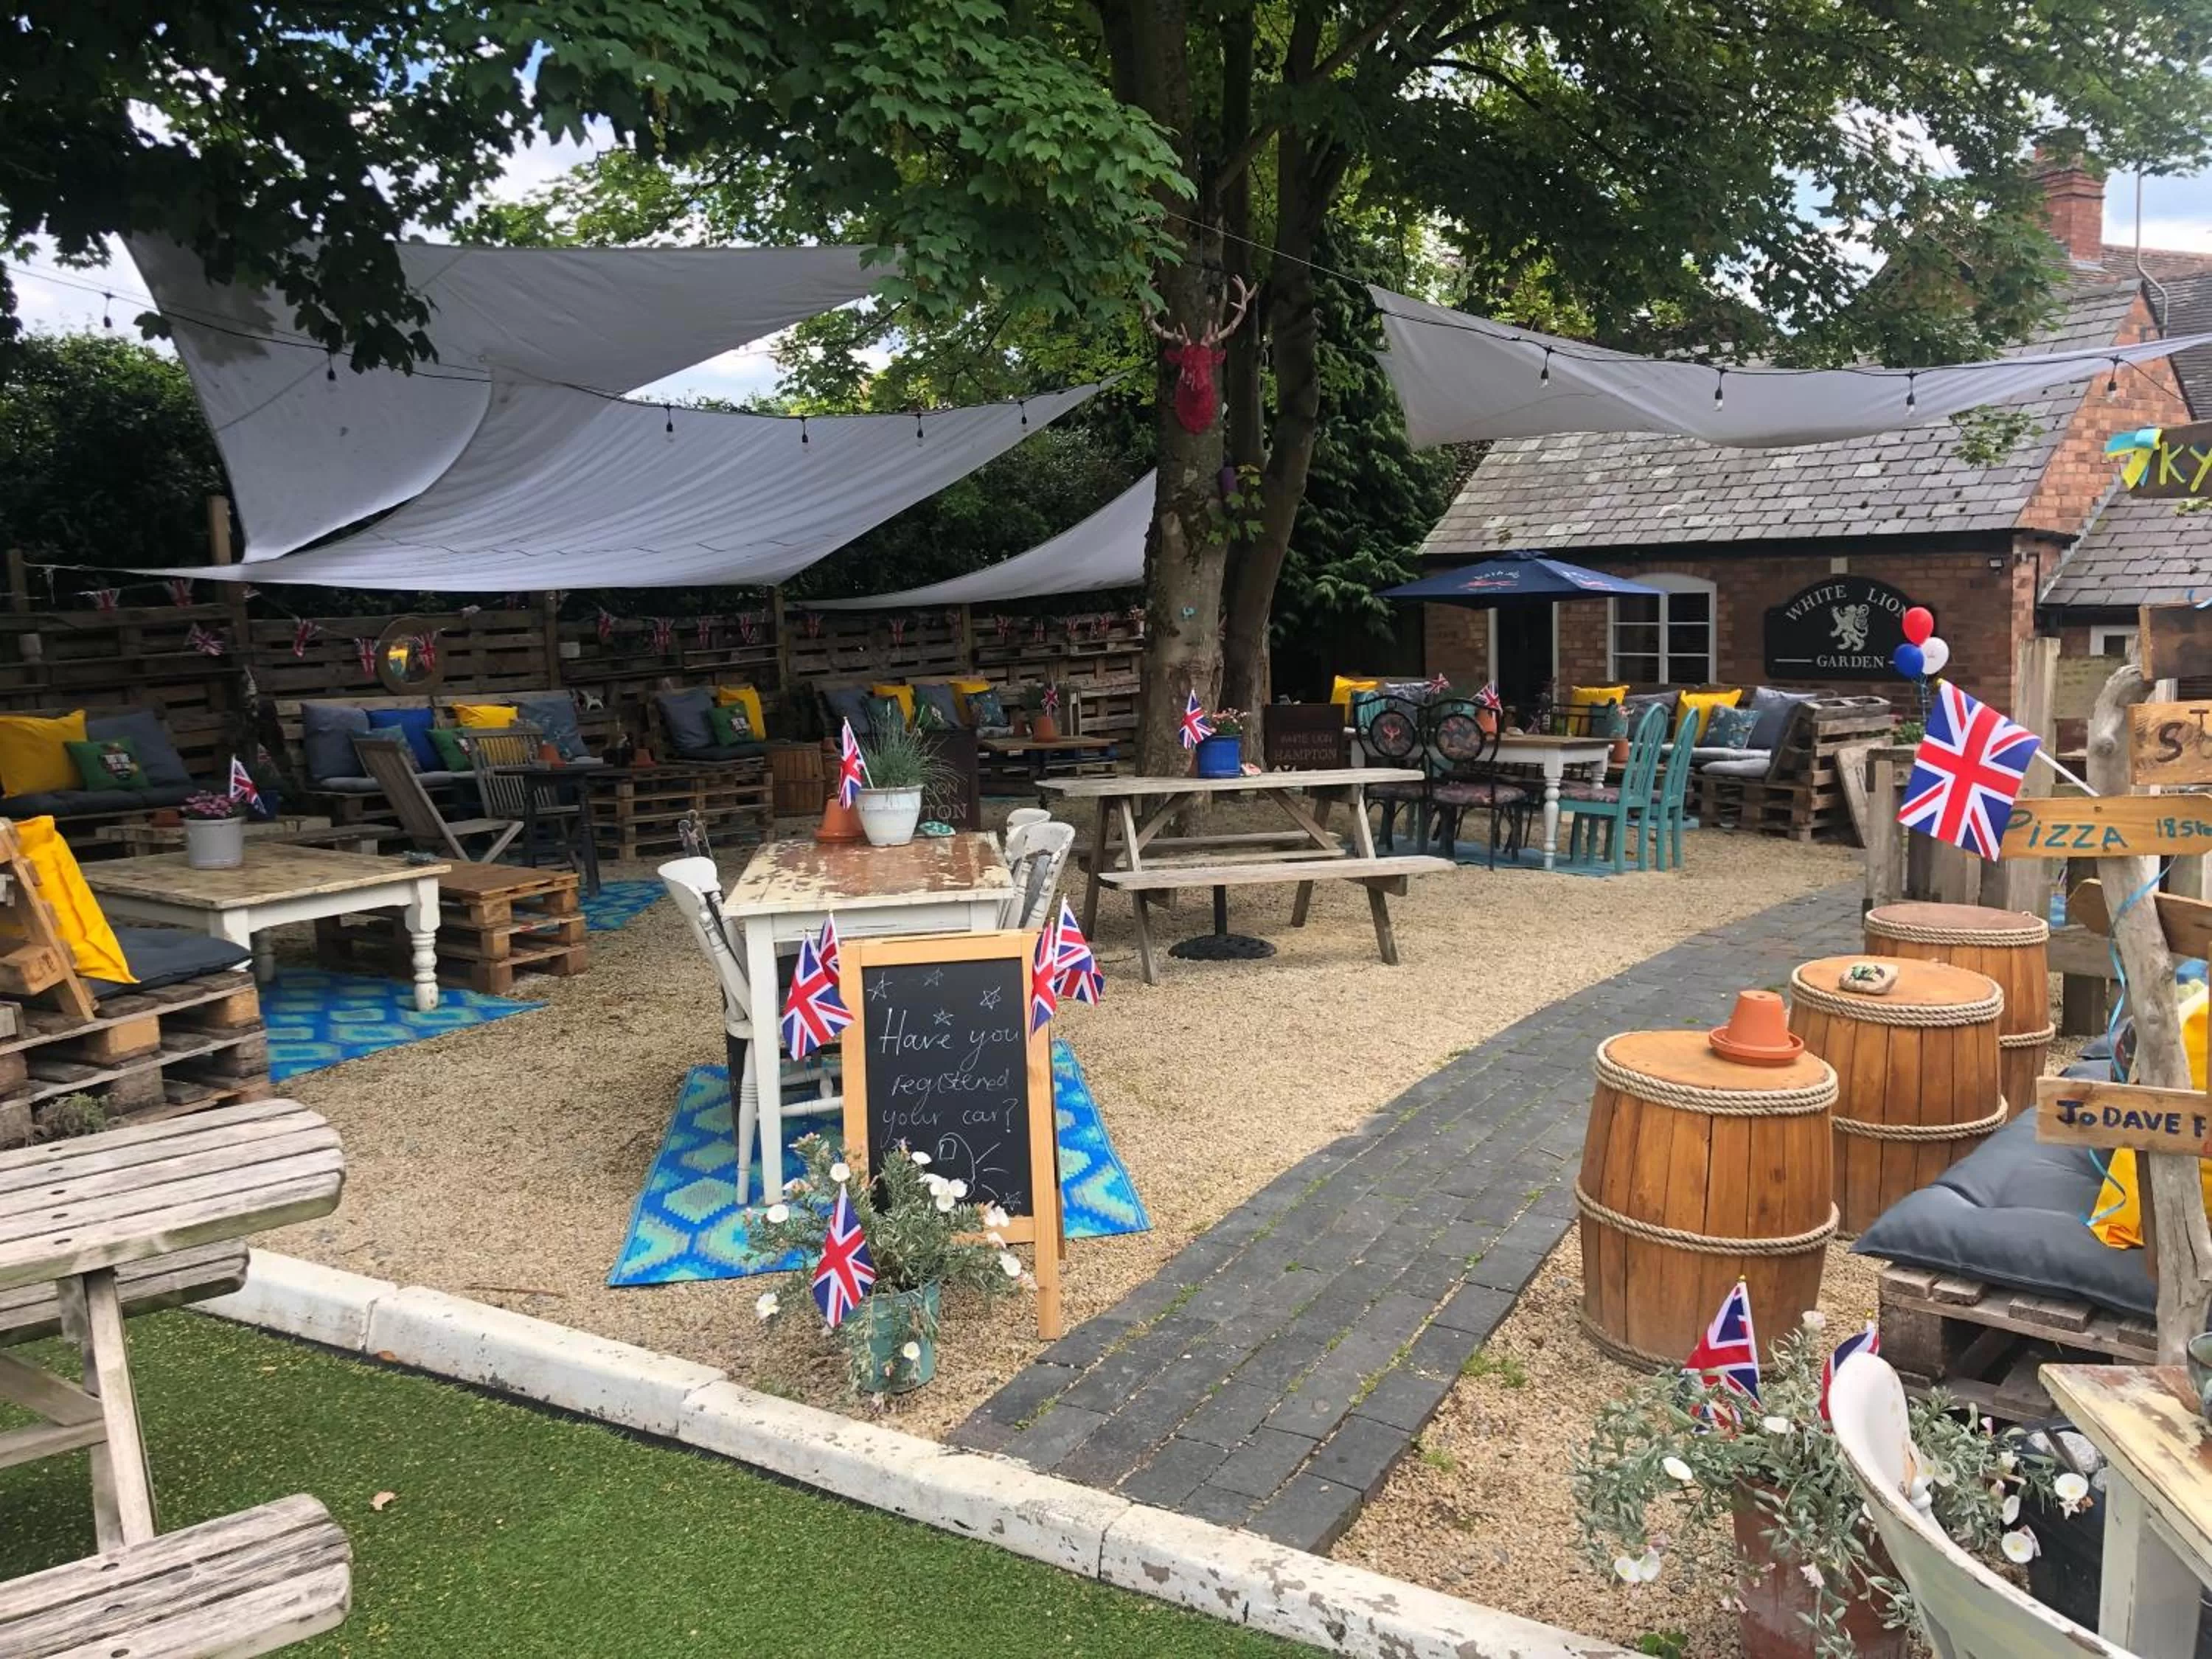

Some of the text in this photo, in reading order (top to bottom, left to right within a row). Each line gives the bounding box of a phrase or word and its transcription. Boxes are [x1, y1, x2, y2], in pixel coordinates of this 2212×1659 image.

[1784, 585, 1846, 621] WHITE
[1816, 654, 1885, 669] GARDEN
[878, 1007, 1020, 1071] Have you
[880, 1098, 1019, 1148] your car?
[2102, 1106, 2182, 1135] DAVE
